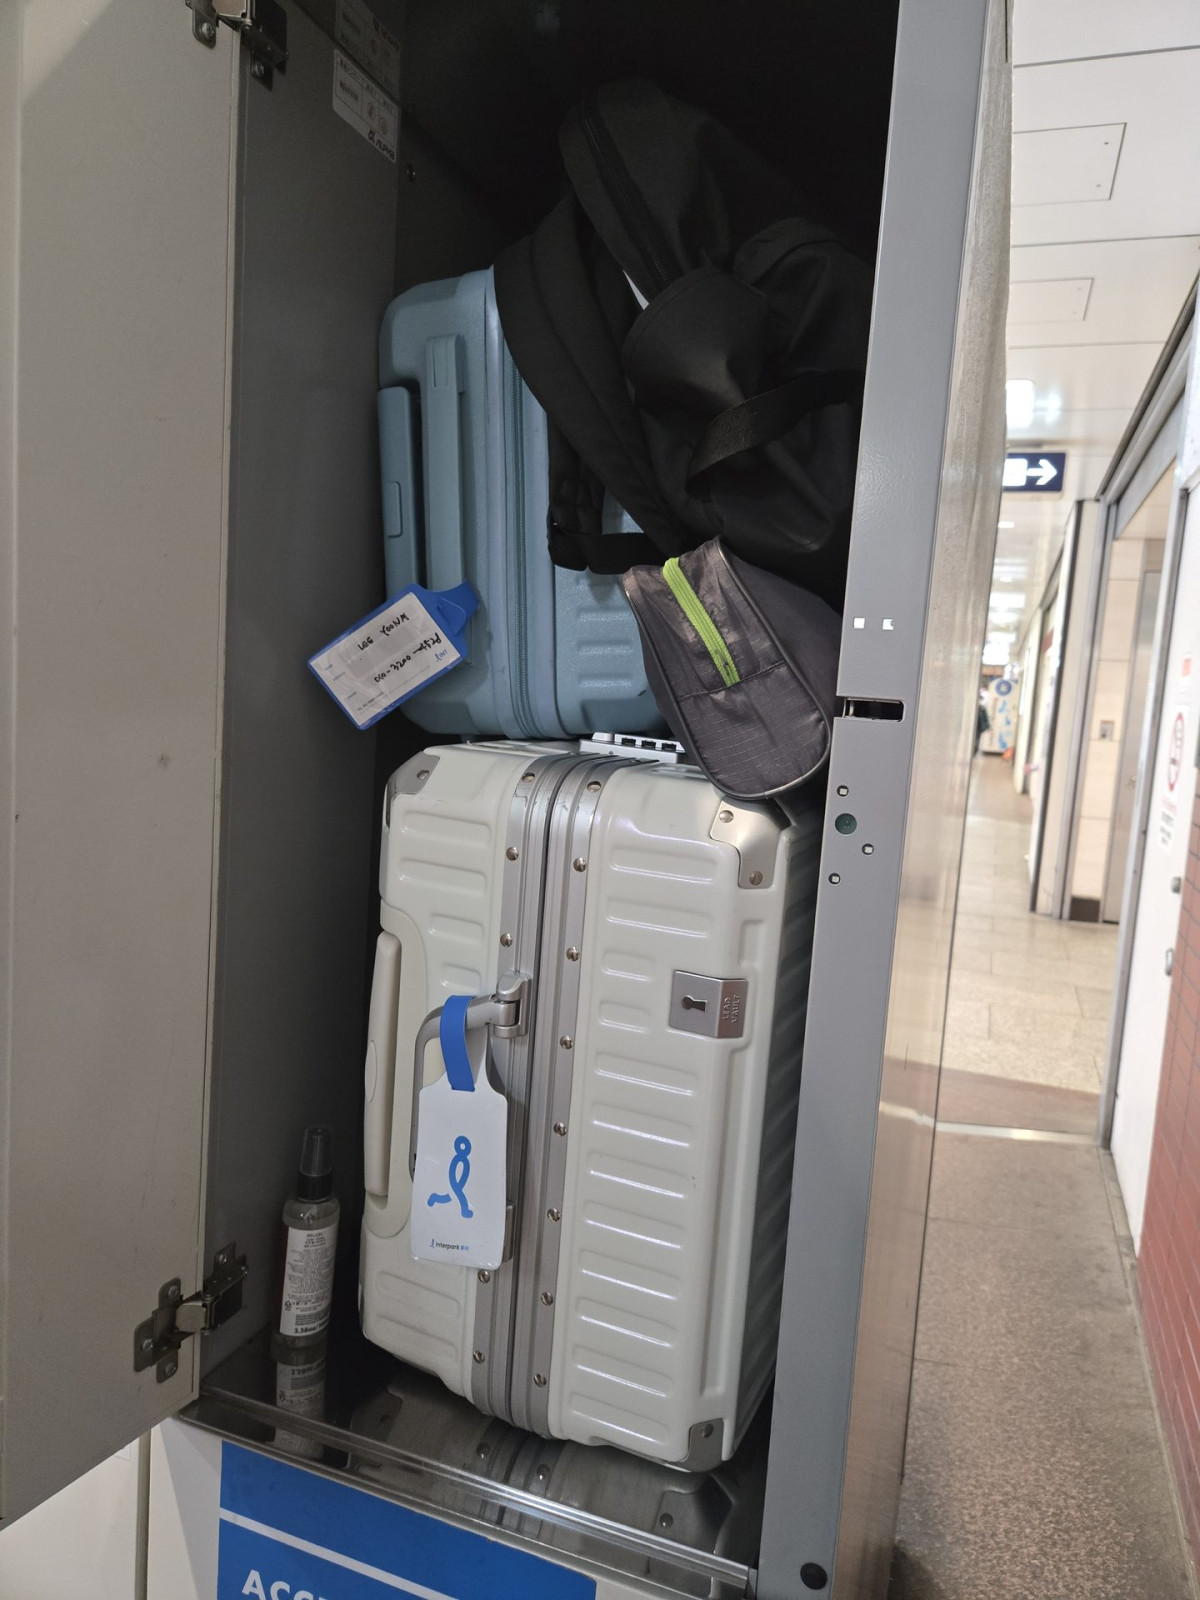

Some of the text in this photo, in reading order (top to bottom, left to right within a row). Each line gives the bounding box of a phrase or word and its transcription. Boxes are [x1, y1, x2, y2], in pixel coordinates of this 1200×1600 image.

[722, 997, 731, 1020] LEAD
[731, 994, 741, 1023] VAULT
[435, 1241, 460, 1251] interpark
